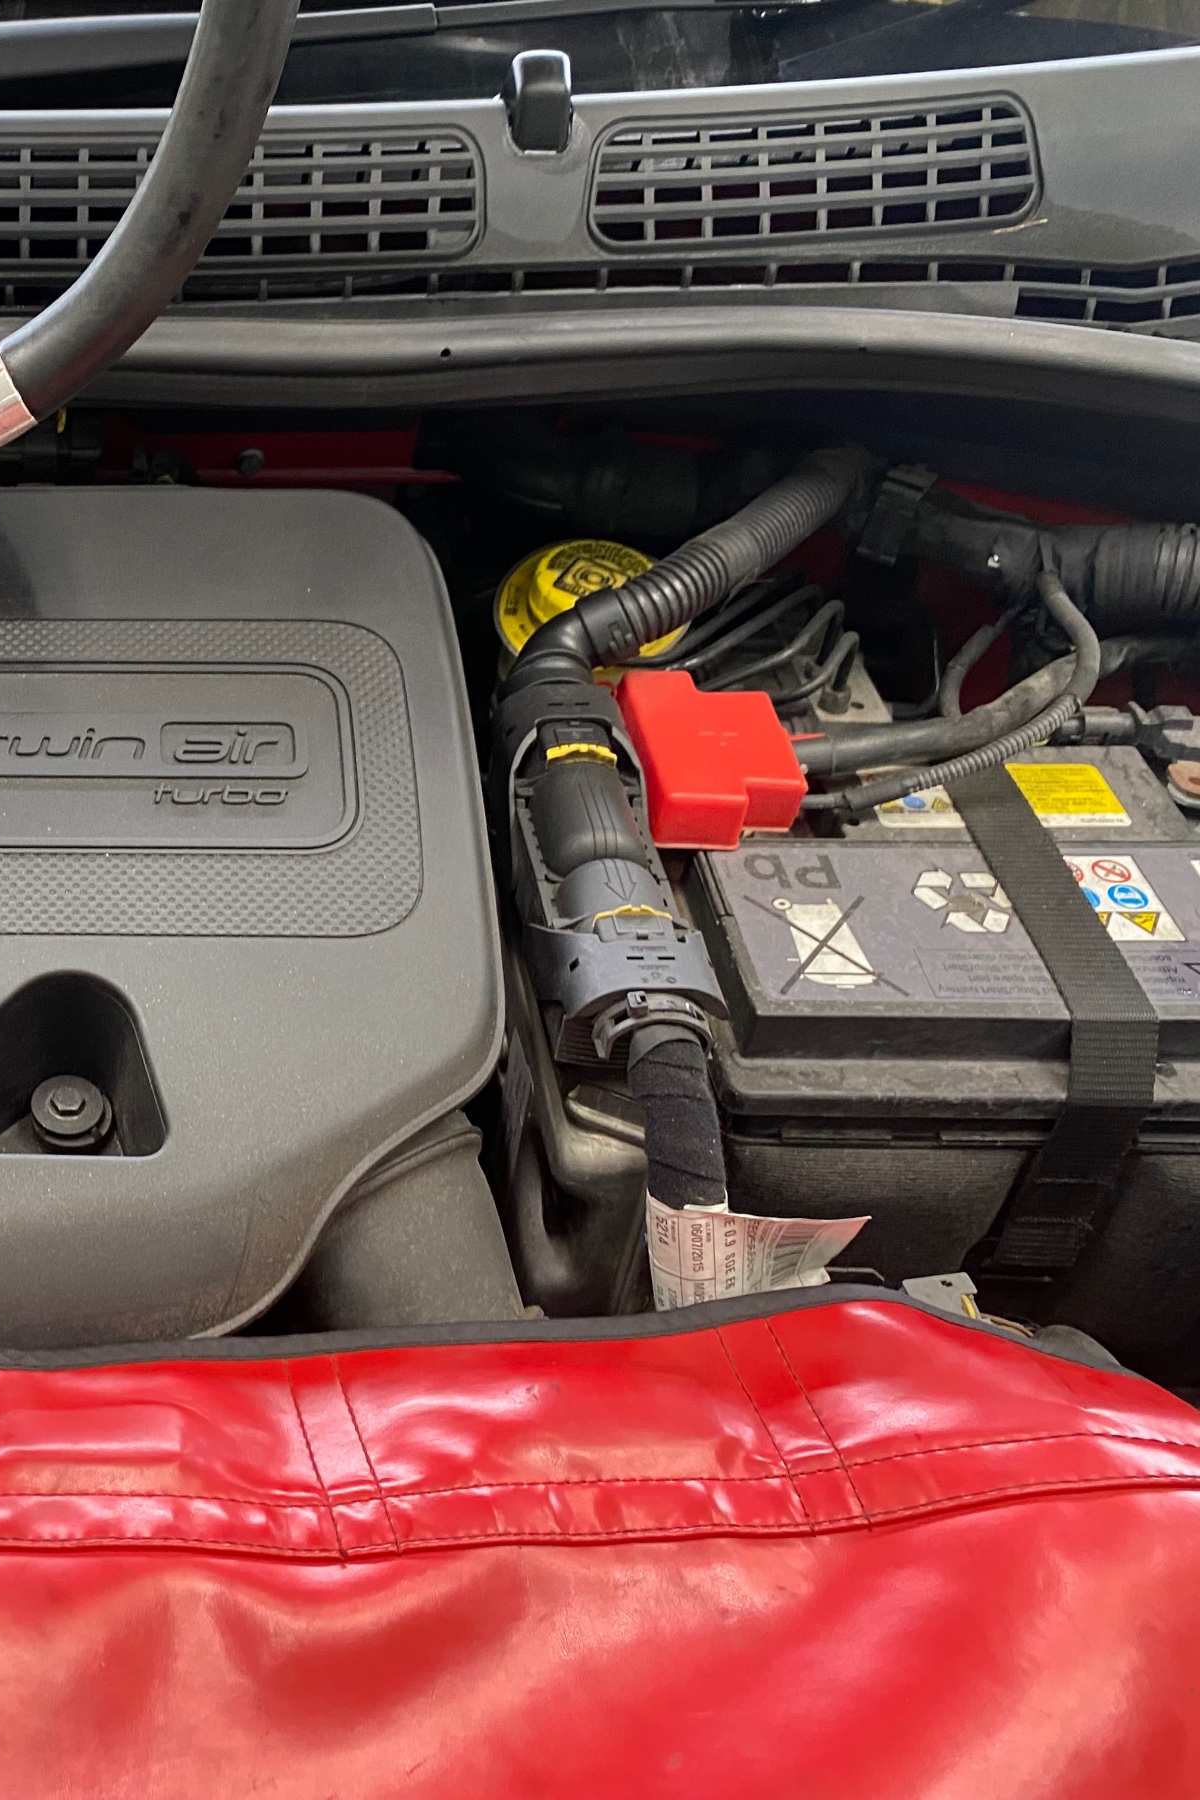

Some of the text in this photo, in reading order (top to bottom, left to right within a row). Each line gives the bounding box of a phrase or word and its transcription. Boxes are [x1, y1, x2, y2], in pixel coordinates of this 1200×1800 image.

[173, 729, 280, 764] air
[154, 783, 289, 805] turbo
[743, 854, 842, 890] Pb
[655, 1215, 670, 1246] 5214
[723, 1230, 737, 1247] 0.9
[691, 1223, 705, 1273] 06/07/2015
[724, 1252, 736, 1276] SGE
